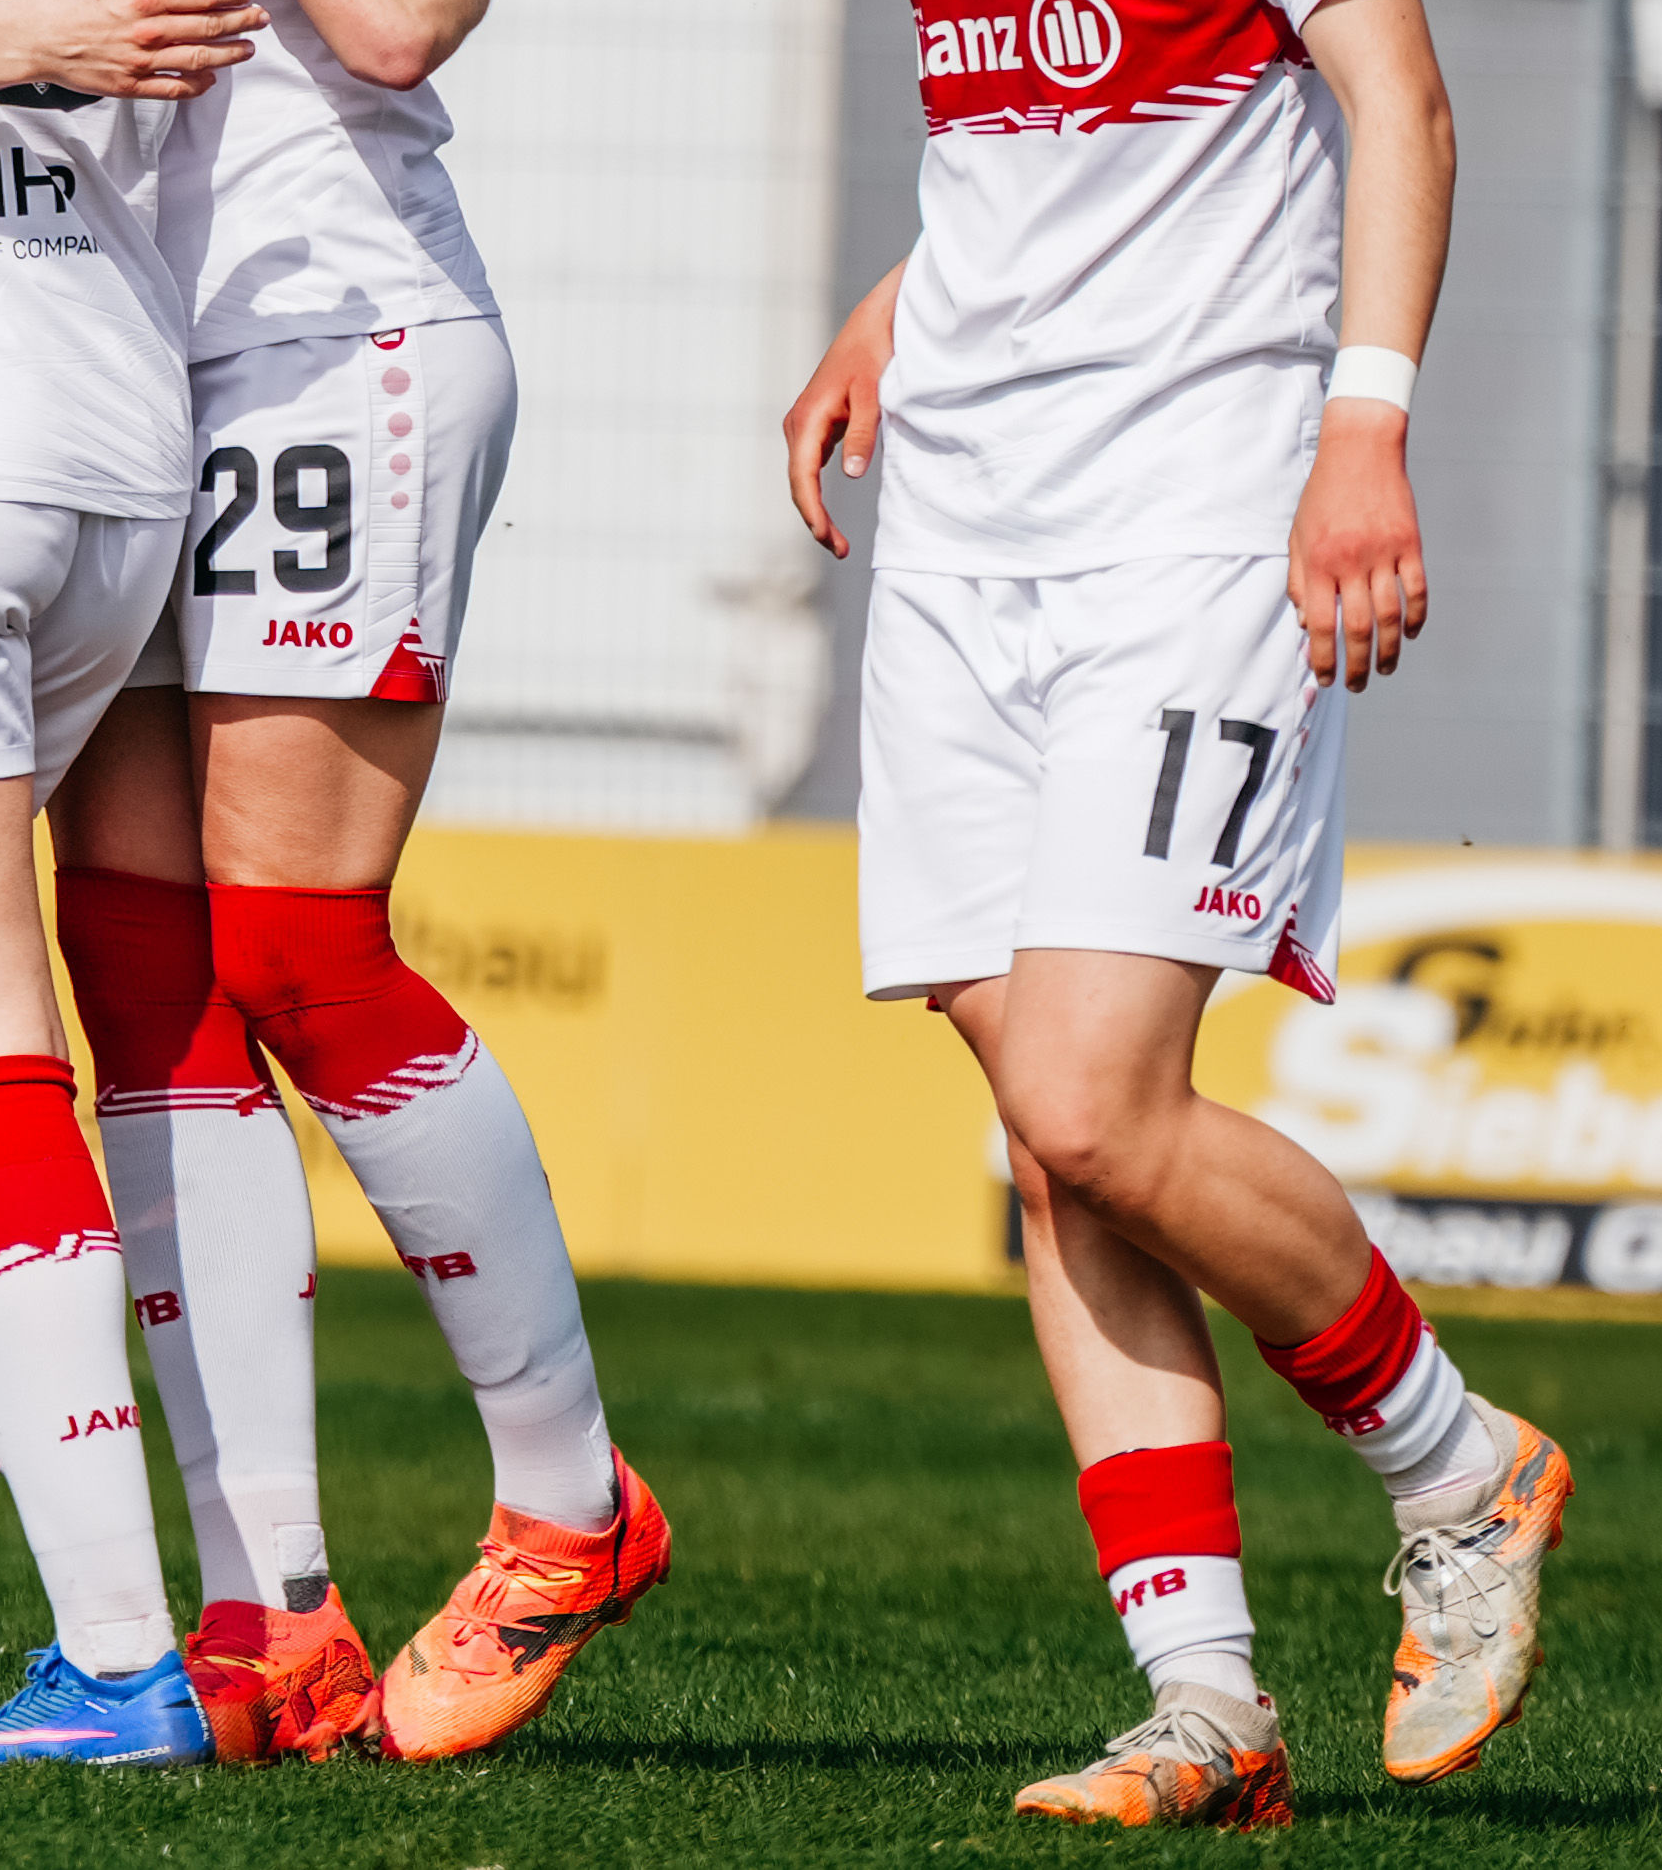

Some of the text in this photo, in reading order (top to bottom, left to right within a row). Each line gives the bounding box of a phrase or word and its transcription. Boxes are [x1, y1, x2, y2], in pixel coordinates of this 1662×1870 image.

[193, 444, 352, 597] 29
[262, 619, 354, 649] JAKO
[1143, 708, 1279, 870] 17
[1193, 885, 1262, 921] JAKO
[1112, 1567, 1188, 1617] VfB
